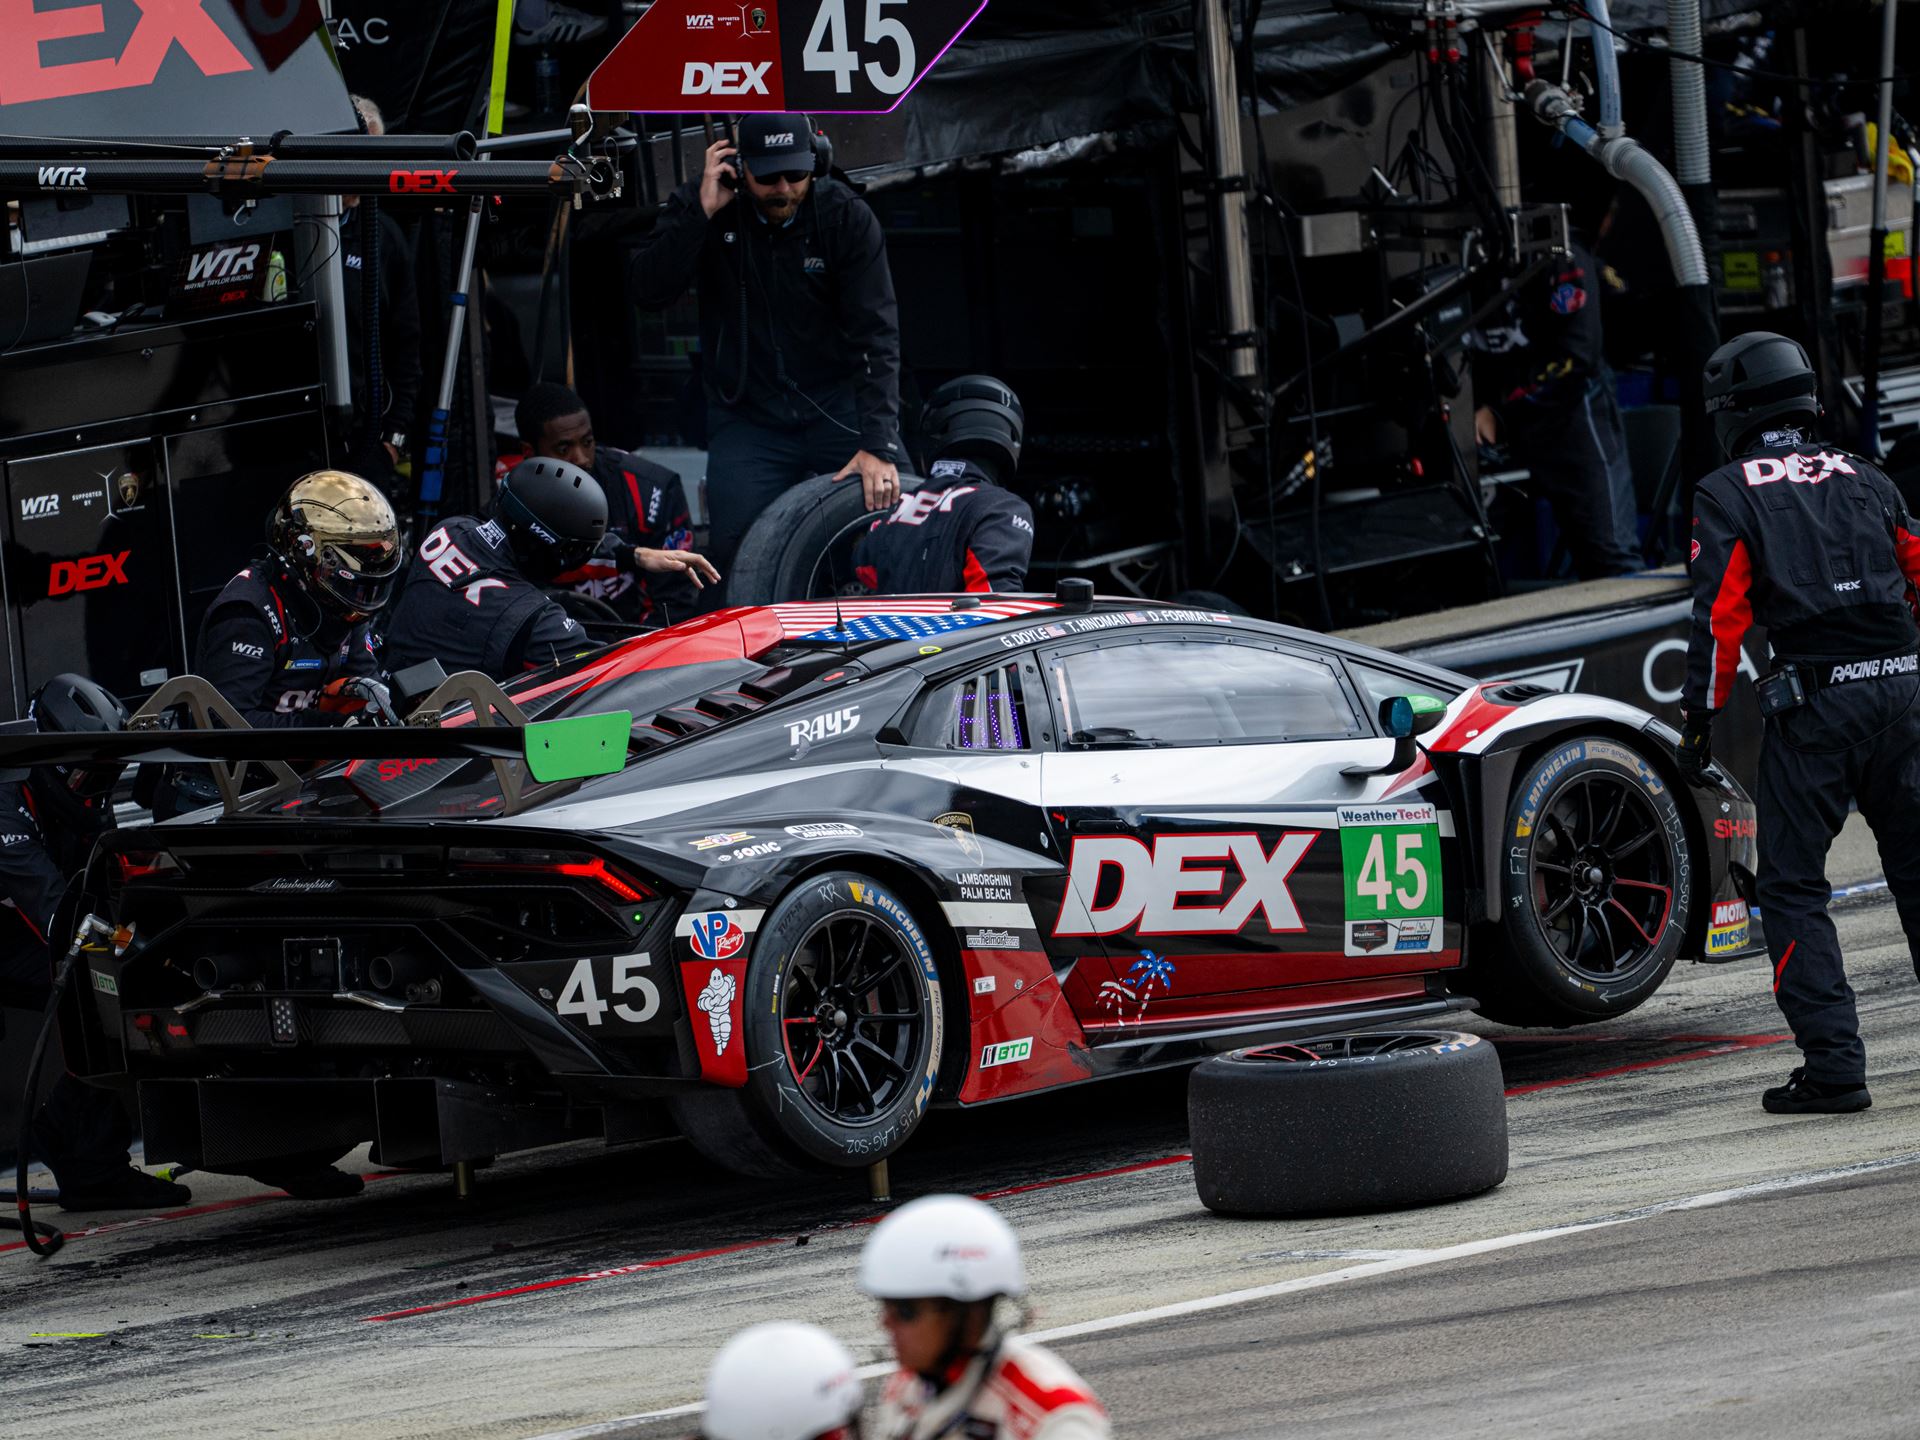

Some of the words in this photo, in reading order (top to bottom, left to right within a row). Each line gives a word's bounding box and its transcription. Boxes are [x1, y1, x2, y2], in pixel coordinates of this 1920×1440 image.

[686, 15, 714, 26] WTR
[803, 0, 916, 95] 45
[681, 62, 773, 95] DEX
[764, 133, 794, 145] WTR
[38, 167, 87, 186] WTR
[390, 170, 459, 193] DEX
[187, 244, 260, 281] WTR
[1742, 451, 1856, 486] DEX
[21, 494, 59, 515] WTR
[72, 491, 103, 501] SUPPORTED
[47, 550, 132, 597] DEX
[1834, 579, 1862, 592] HRX
[1001, 635, 1013, 648] G.
[1014, 627, 1049, 645] DOYLE
[1066, 621, 1076, 633] T.
[1077, 613, 1130, 632] HINDMAN
[1149, 611, 1162, 622] D.
[1162, 610, 1212, 623] FORMAL
[232, 641, 264, 657] WTR
[1829, 659, 1880, 684] RACING
[784, 705, 860, 746] RAYS
[1529, 746, 1581, 806] MICHELIN
[1342, 808, 1431, 822] WeatherTech
[956, 873, 1012, 887] LAMBORGHINI
[1051, 831, 1322, 937] DEX
[1357, 833, 1428, 910] 45
[818, 883, 846, 903] RR
[961, 887, 983, 899] PALM
[985, 888, 1012, 900] BEACH
[691, 912, 729, 957] VP
[718, 933, 742, 952] Racing
[877, 895, 935, 973] MICHELIN
[556, 952, 660, 1026] 45
[998, 1042, 1029, 1060] GTD
